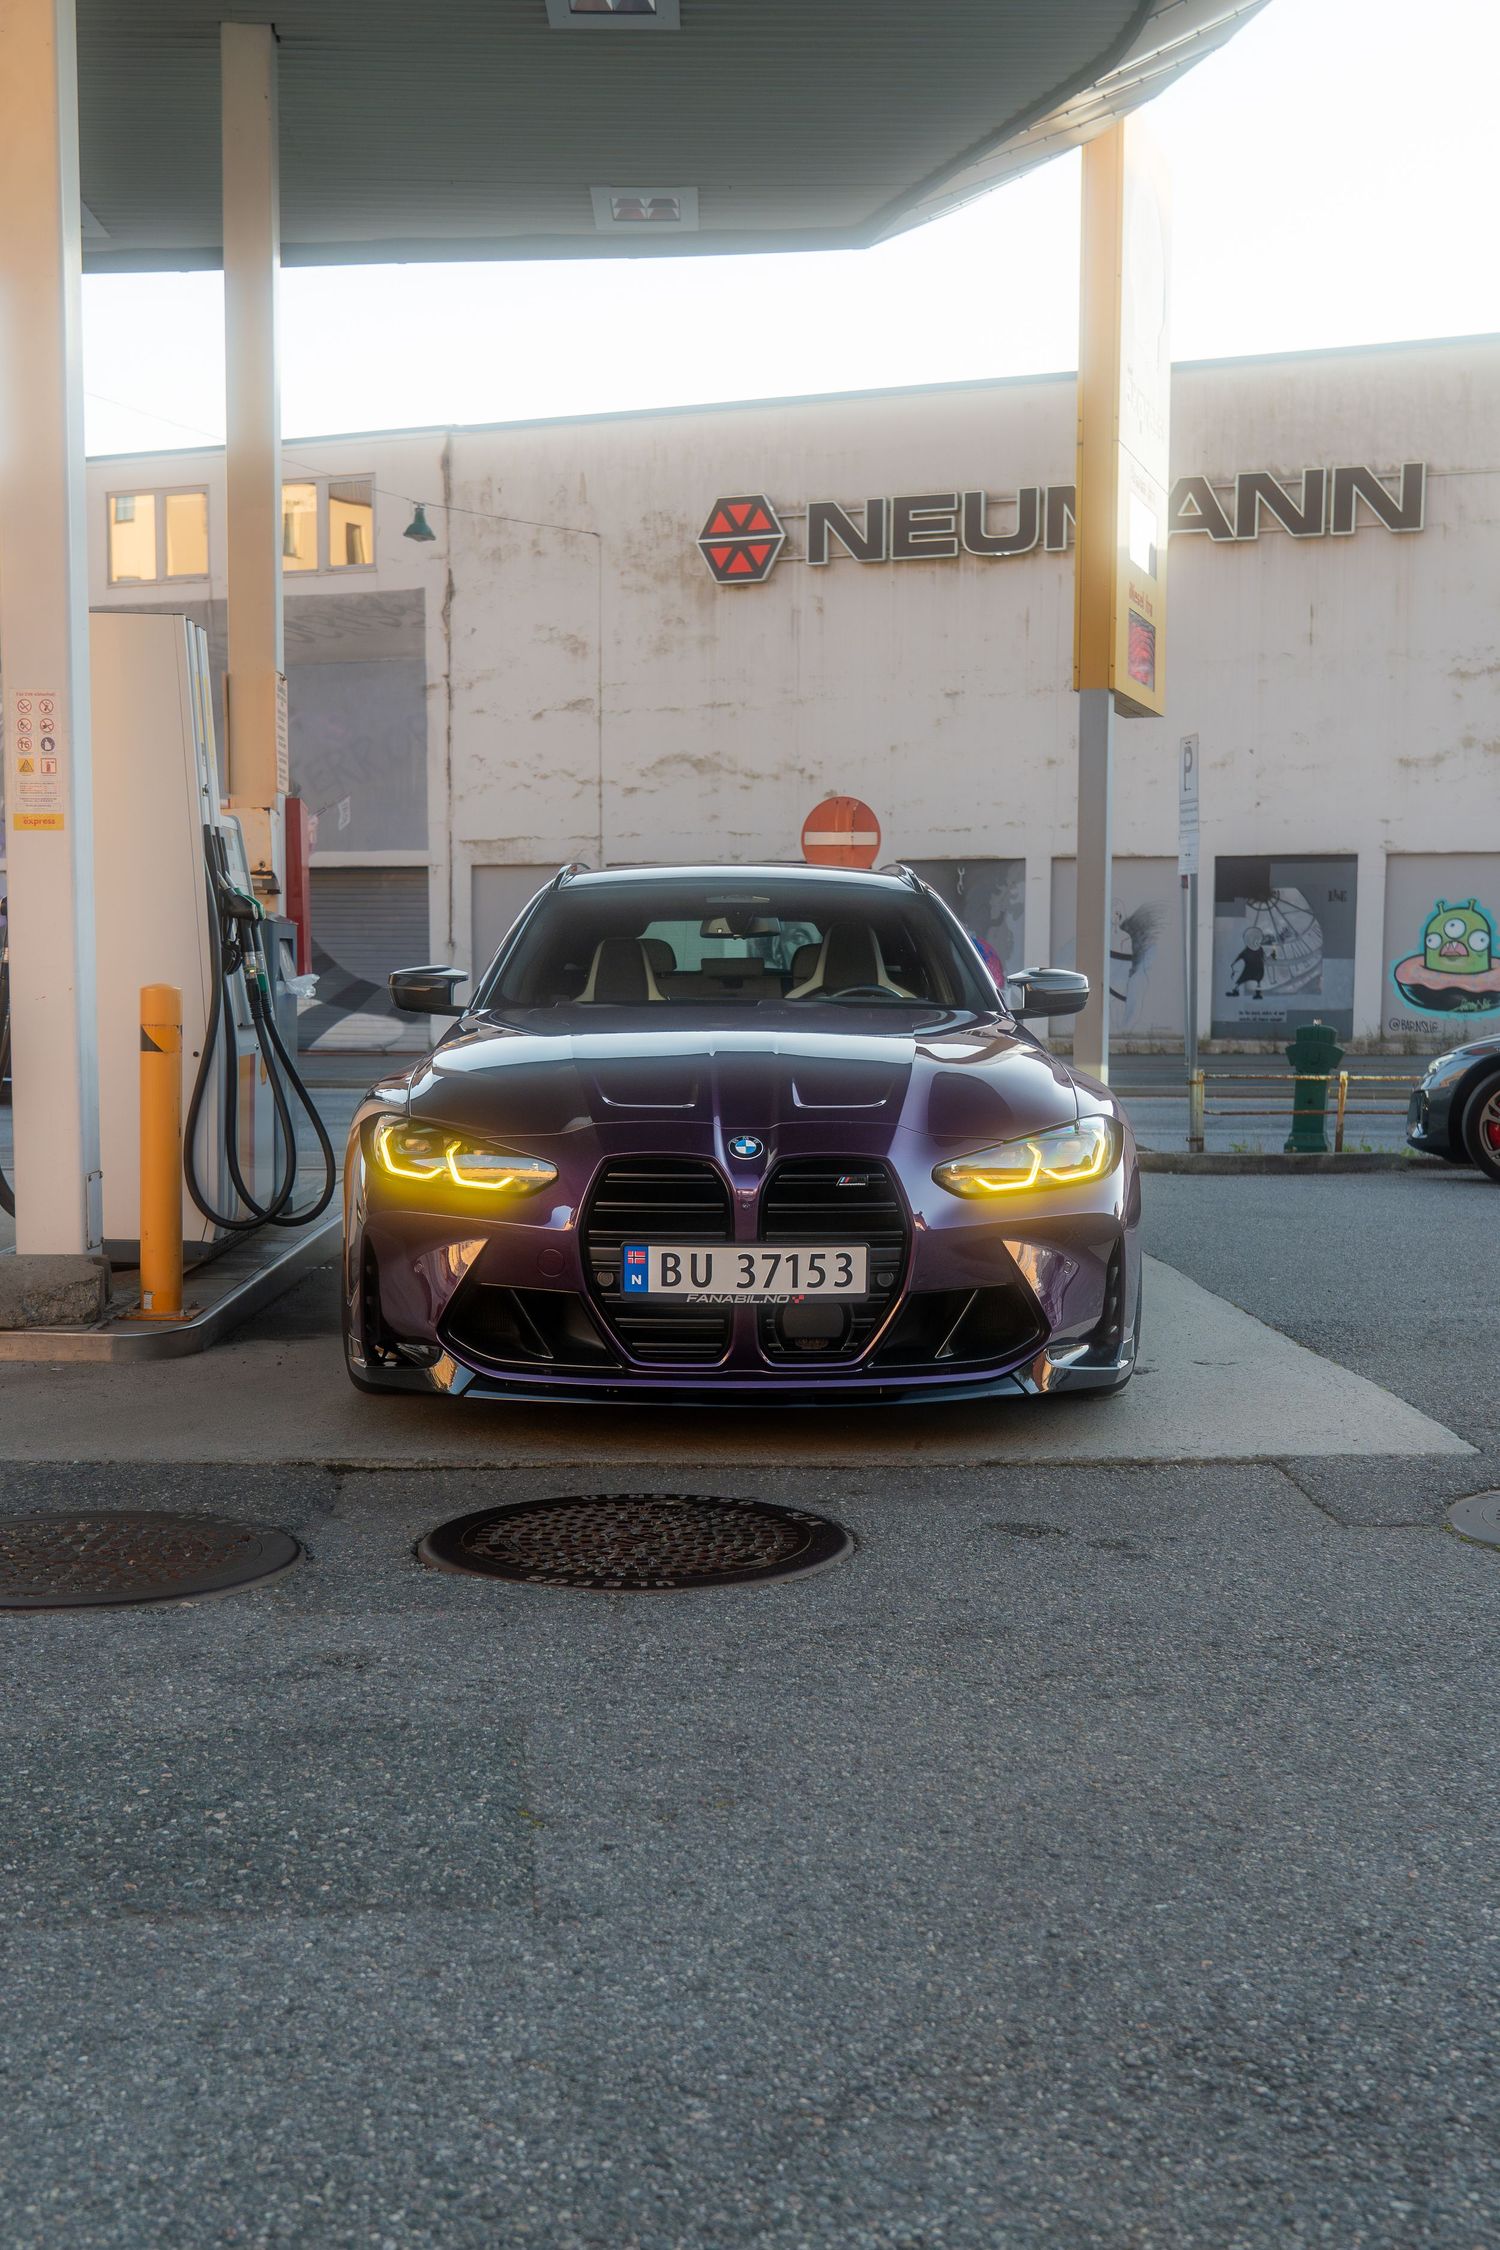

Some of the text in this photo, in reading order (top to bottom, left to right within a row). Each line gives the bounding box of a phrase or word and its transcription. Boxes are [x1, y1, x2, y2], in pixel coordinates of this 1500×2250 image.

[23, 818, 56, 827] express
[660, 1252, 853, 1289] BU 37153
[631, 1274, 642, 1285] N
[686, 1293, 790, 1304] FANABIL.NO
[525, 1575, 677, 1588] ULEFOS
